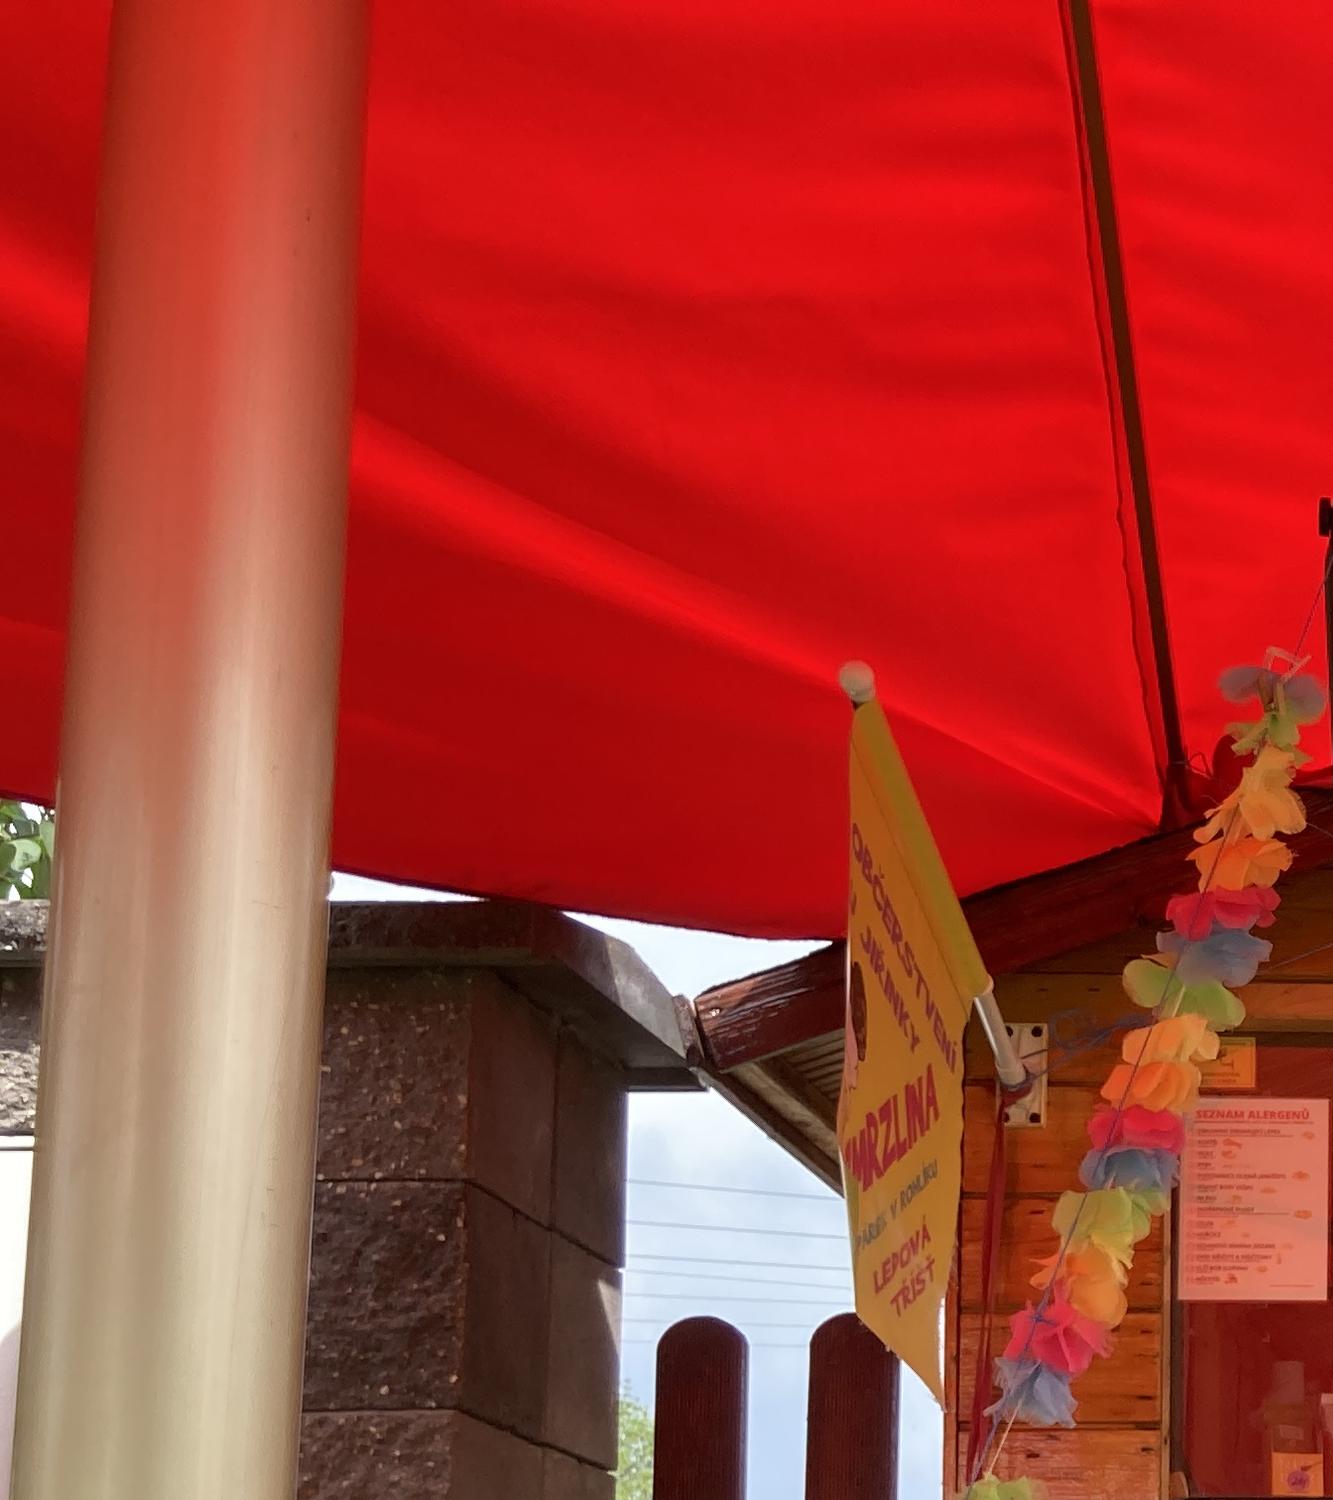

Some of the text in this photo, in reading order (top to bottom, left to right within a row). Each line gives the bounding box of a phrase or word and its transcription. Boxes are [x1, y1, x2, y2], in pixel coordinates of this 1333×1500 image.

[852, 823, 957, 1073] OBČERSTVENÍ
[1196, 1109, 1310, 1120] SEZNAM ALERGENŮ
